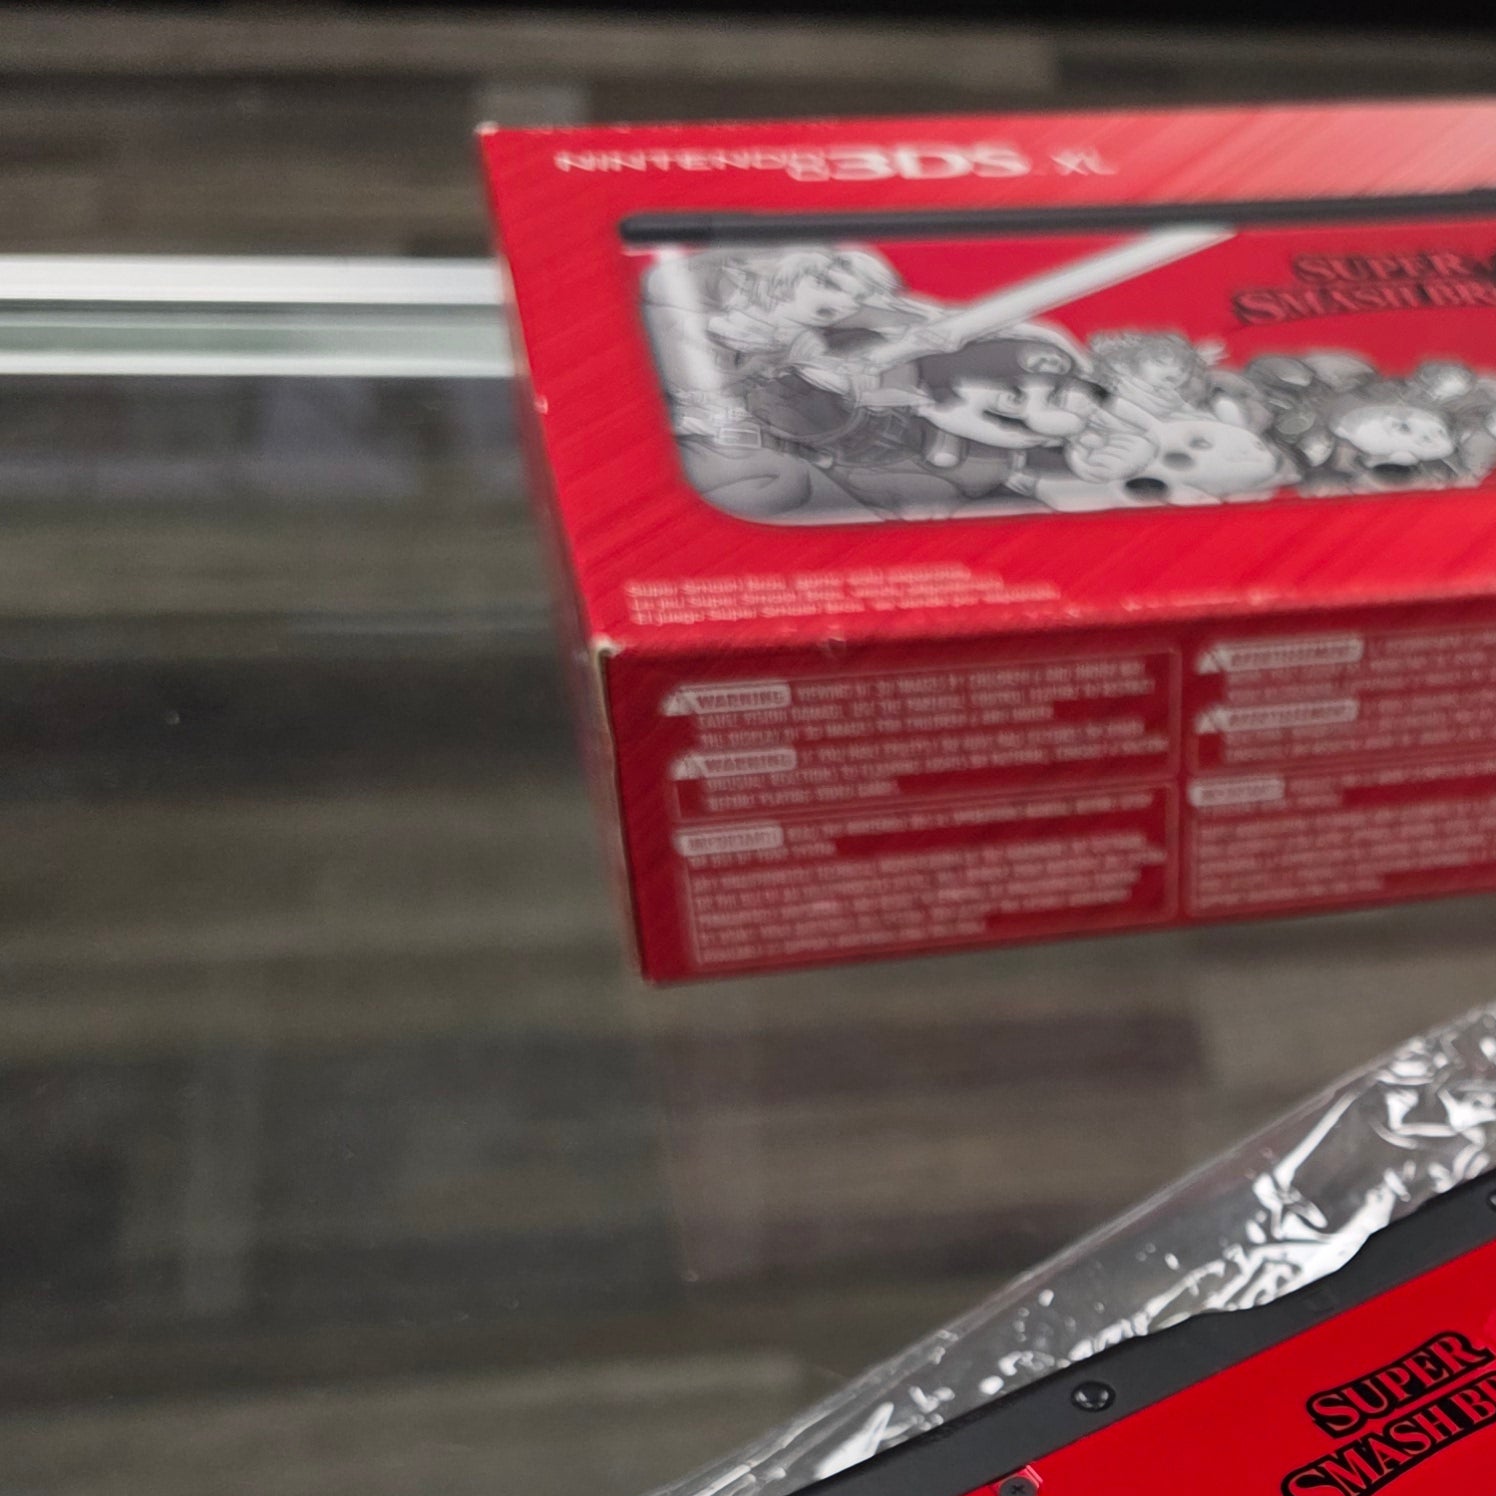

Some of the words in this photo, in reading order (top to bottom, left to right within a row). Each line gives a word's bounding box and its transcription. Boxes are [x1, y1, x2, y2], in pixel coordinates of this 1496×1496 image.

[827, 145, 1031, 181] 3DS
[1049, 150, 1117, 176] XL
[1294, 250, 1472, 285] SUPER
[1308, 1332, 1493, 1436] SUPER
